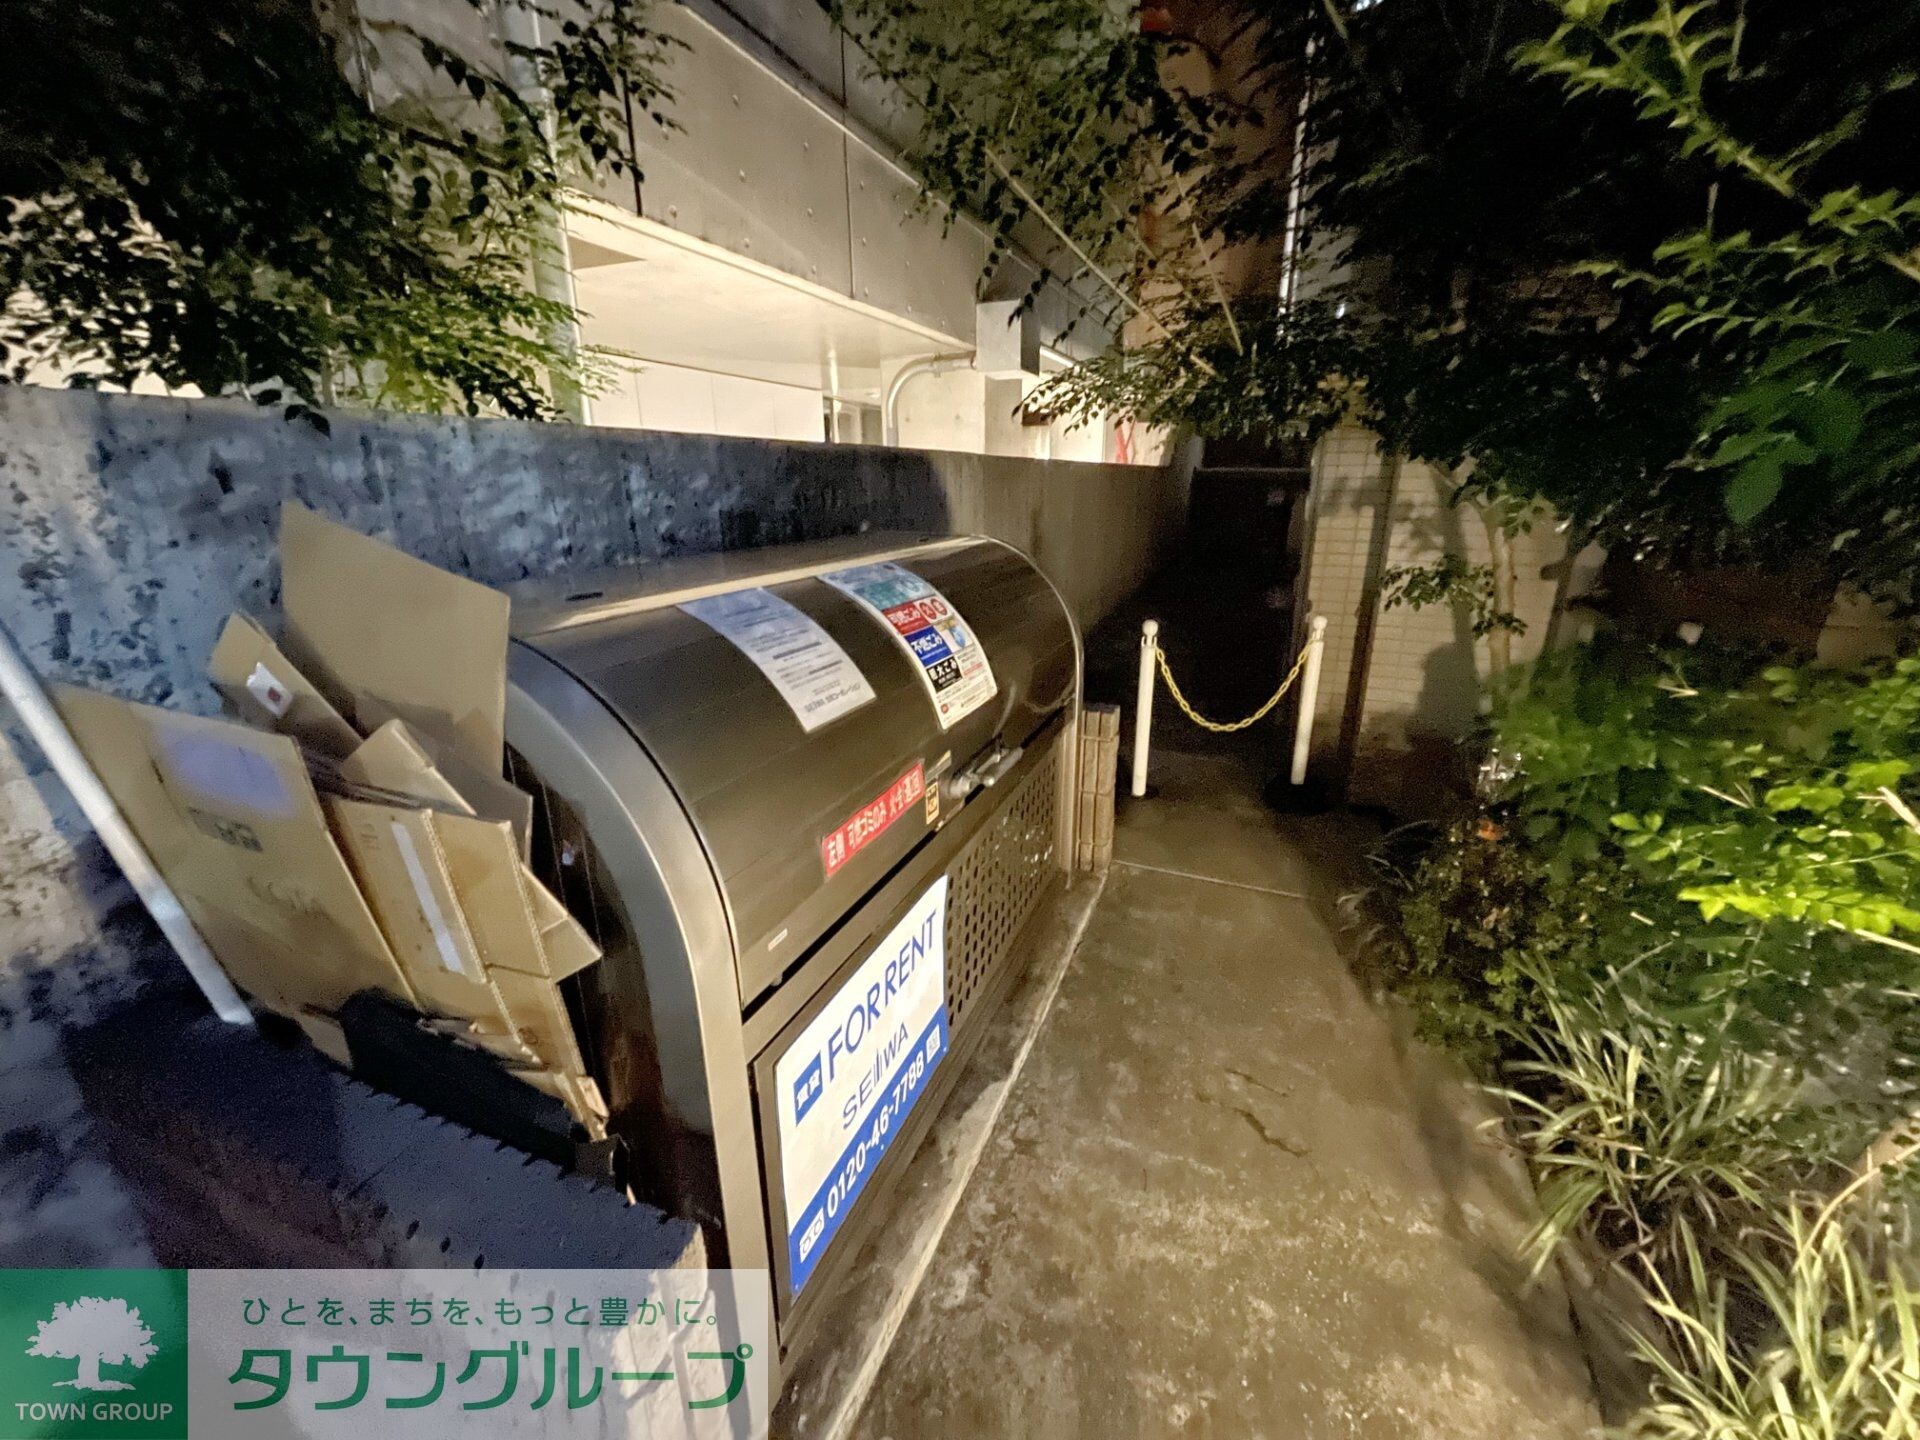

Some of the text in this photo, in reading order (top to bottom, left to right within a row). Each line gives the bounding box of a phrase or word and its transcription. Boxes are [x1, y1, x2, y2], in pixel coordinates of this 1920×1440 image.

[827, 909, 937, 1082] FOR RENT
[827, 1050, 925, 1218] 0120-46-7788
